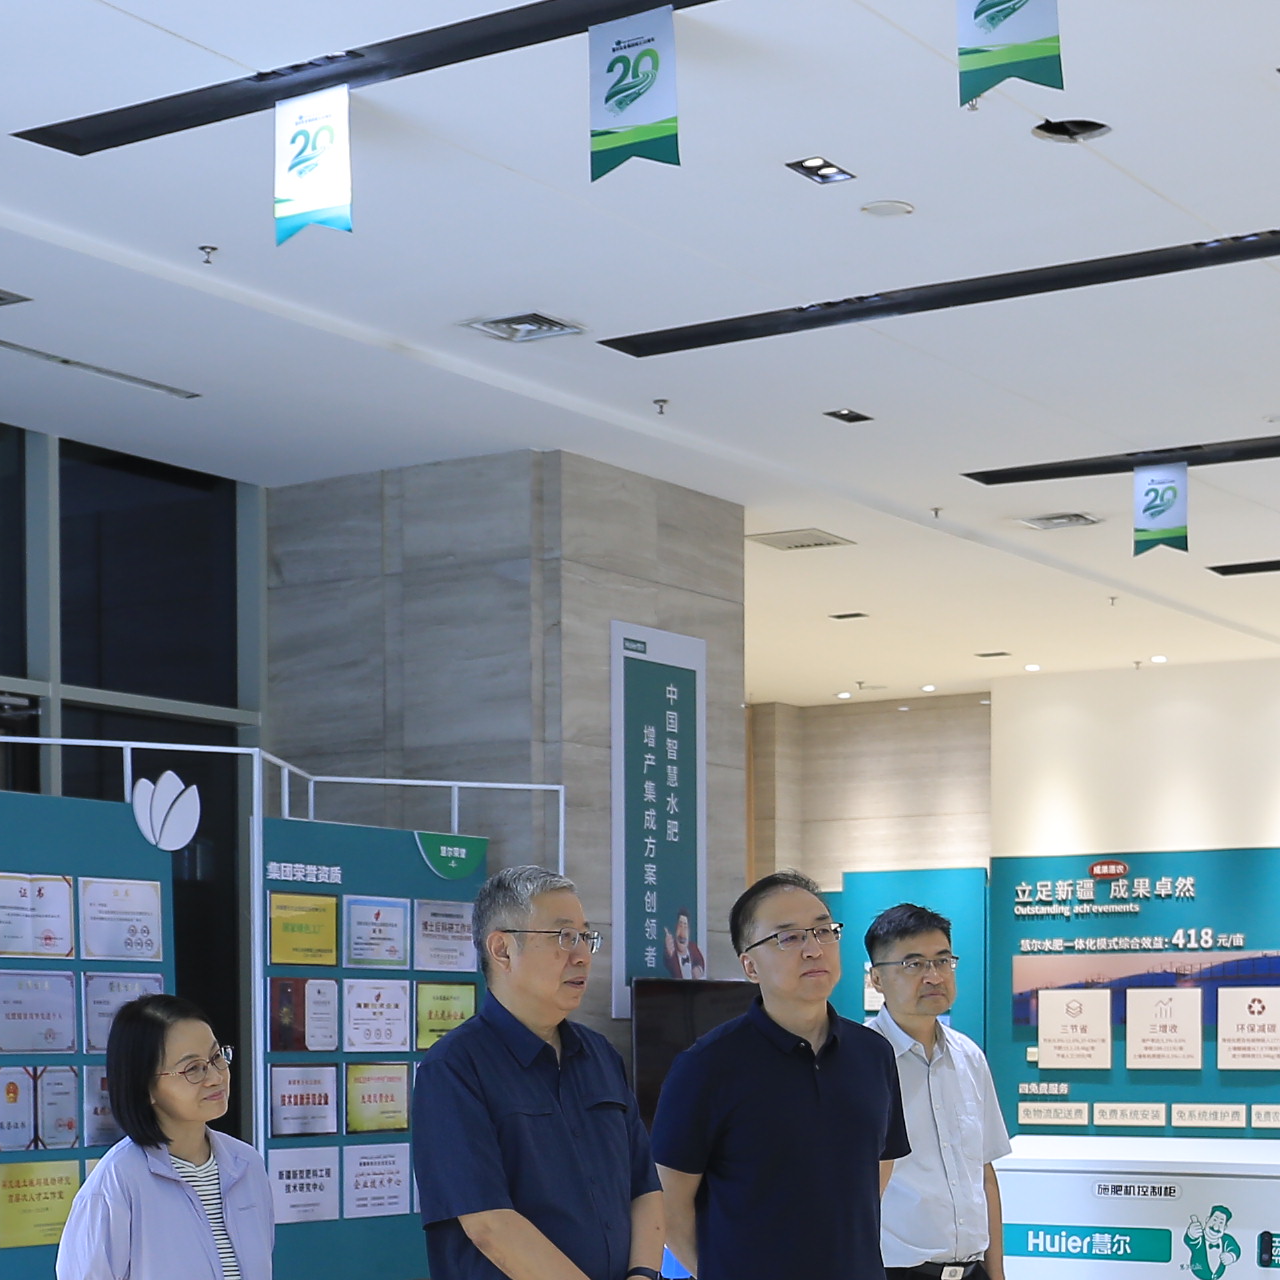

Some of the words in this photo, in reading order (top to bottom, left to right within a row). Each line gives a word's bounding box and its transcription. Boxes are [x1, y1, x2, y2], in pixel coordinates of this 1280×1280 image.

[605, 48, 659, 105] 20
[288, 124, 335, 172] 20
[1143, 486, 1177, 516] 20
[665, 683, 679, 843] 中国智慧水肥
[643, 725, 657, 969] 增产集成方案创领者
[266, 861, 343, 884] 集团荣誉资质
[1015, 878, 1096, 902] 立足新疆
[1109, 876, 1196, 899] 成果卓然
[1014, 904, 1070, 917] Outstanding
[1172, 928, 1213, 949] 418
[1216, 934, 1245, 948] 元/亩
[1060, 1024, 1088, 1034] 三节省
[1149, 1024, 1178, 1034] 三增收
[1236, 1023, 1277, 1034] 环保减碳
[1022, 1108, 1083, 1119] 免物流配送费
[1098, 1109, 1160, 1121] 免费系统安装
[1175, 1109, 1241, 1122] 免系统维护费
[278, 1168, 331, 1180] 新疆新型肥料工程
[285, 1182, 325, 1194] 技术研究中心
[353, 1177, 402, 1190] 企业技术中心
[1097, 1184, 1177, 1197] 施肥机控制柜
